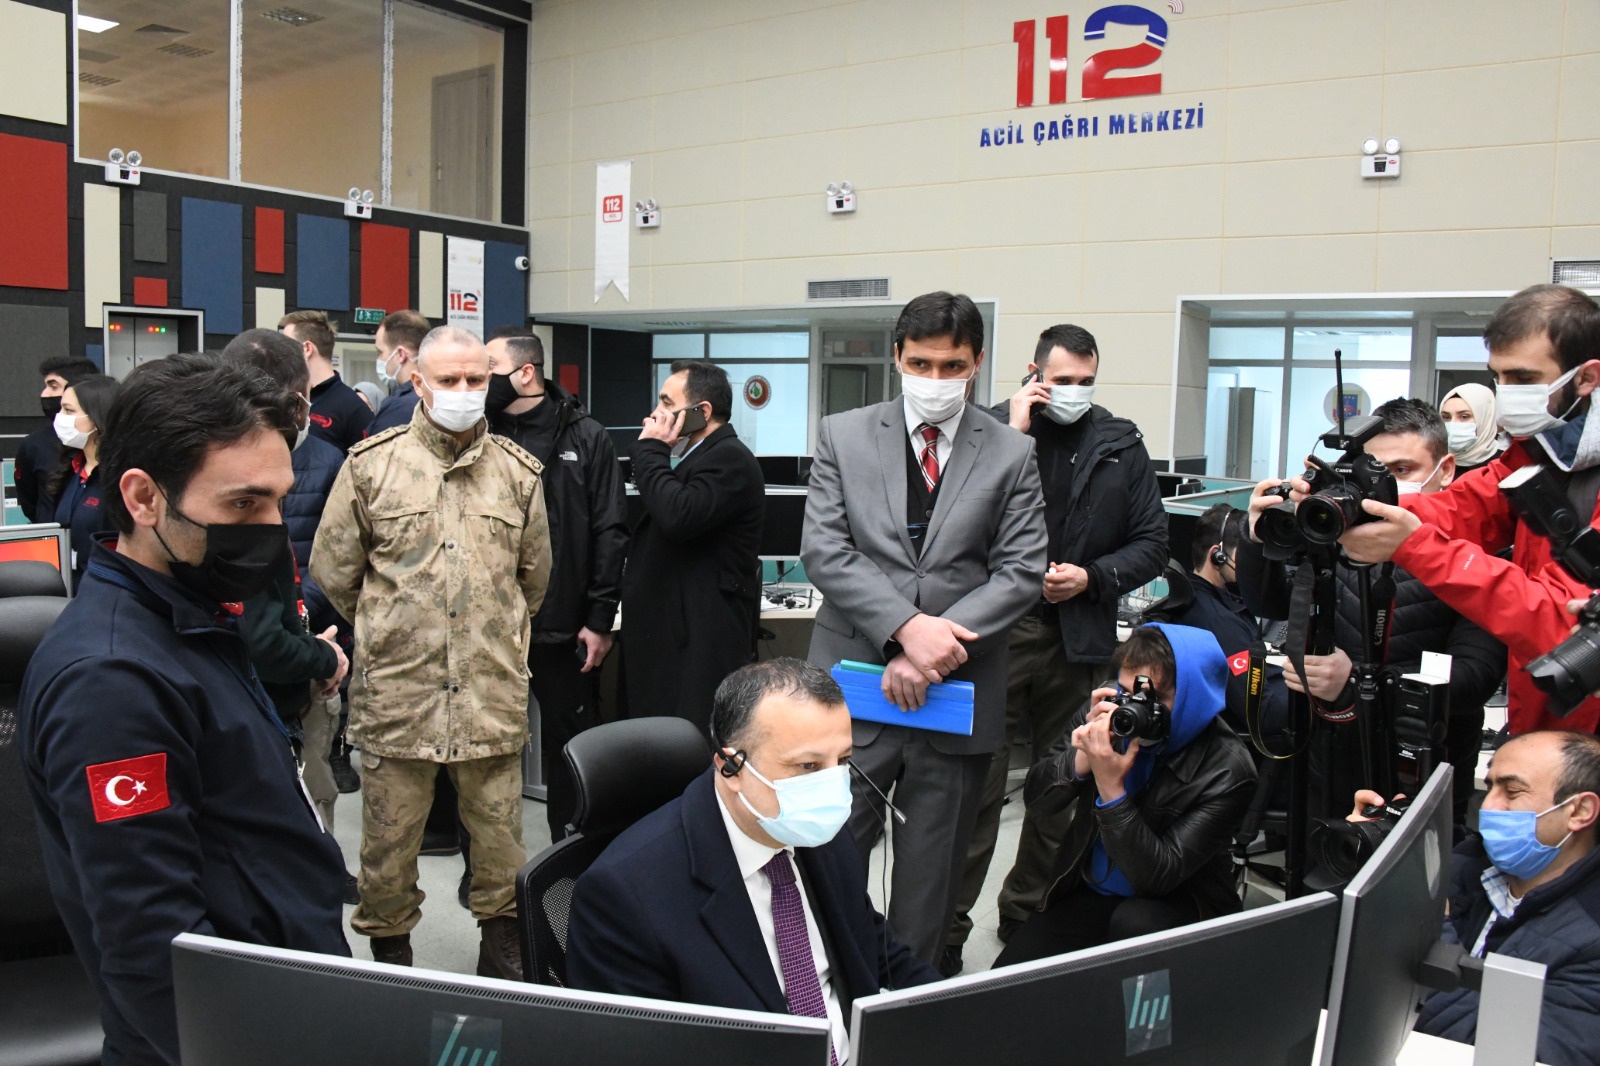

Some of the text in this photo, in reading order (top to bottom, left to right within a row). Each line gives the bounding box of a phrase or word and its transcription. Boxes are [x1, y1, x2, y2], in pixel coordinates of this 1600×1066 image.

[1013, 4, 1168, 108] 112
[979, 102, 1204, 147] ACİL ÇAĞRI MERKEZİ
[605, 197, 621, 212] 112
[450, 292, 478, 312] 112
[1374, 609, 1387, 646] Canon
[1251, 666, 1261, 696] Nikon
